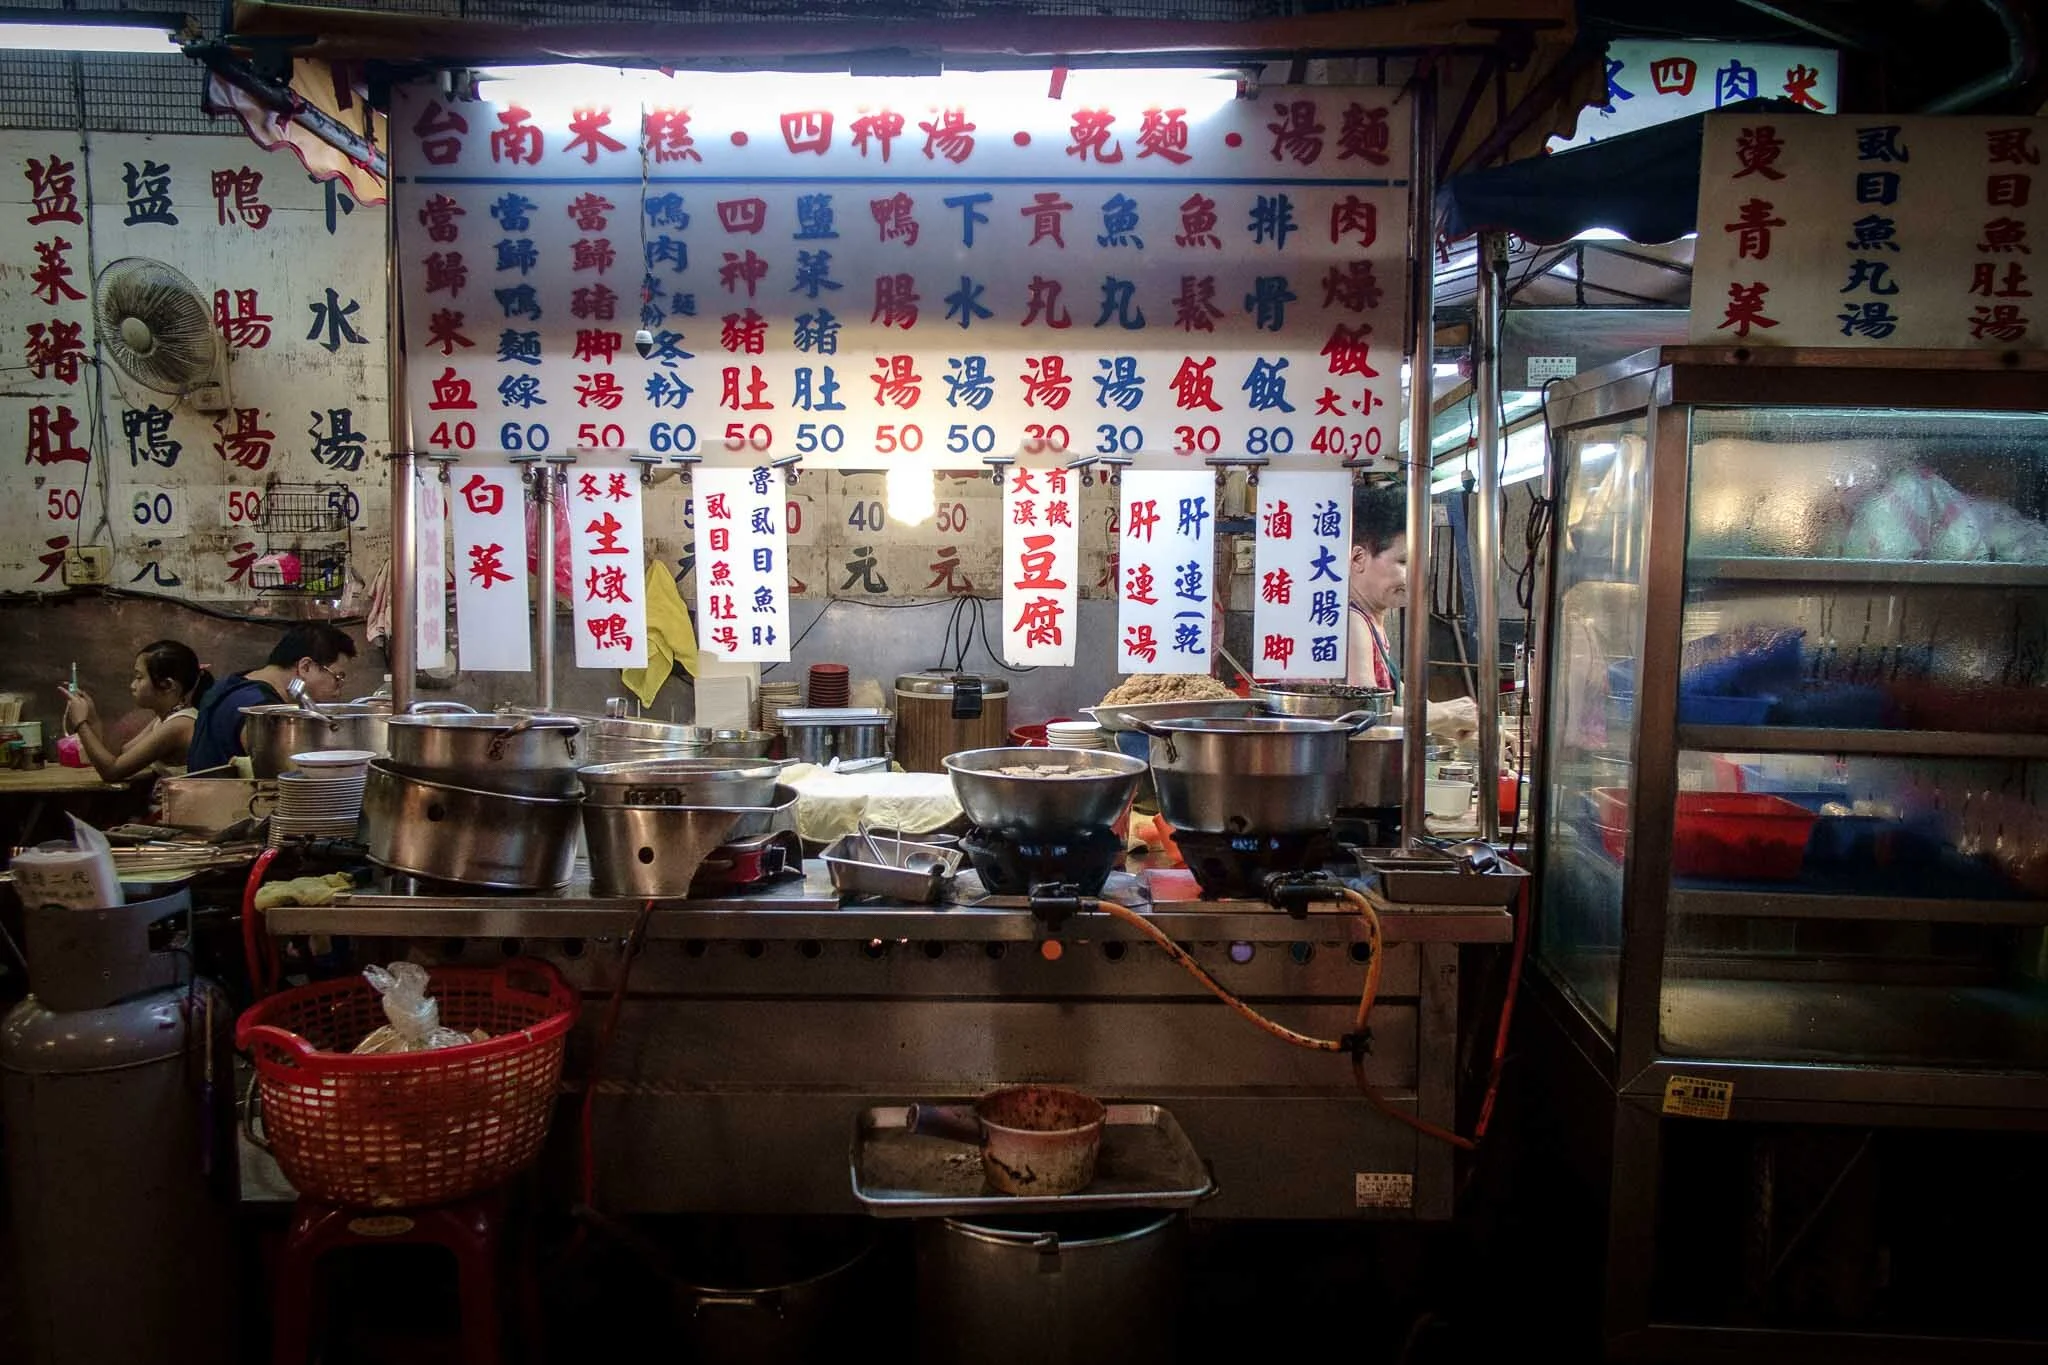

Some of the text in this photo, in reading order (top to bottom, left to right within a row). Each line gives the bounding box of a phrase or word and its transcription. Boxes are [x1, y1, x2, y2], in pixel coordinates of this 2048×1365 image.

[412, 99, 702, 166] 台南米糕
[780, 109, 976, 164] 四神湯
[1837, 126, 1909, 340] 虱目魚丸湯
[1967, 128, 2040, 341] 虱目魚肚湯
[211, 166, 276, 471] 鴨腸湯
[717, 198, 775, 451] 四神豬肚 50
[870, 192, 924, 452] 鴨腸湯 50
[943, 193, 995, 411] 下水湯
[1020, 193, 1073, 453] 貢丸湯 30
[1093, 194, 1146, 454] 魚丸湯 30
[1242, 195, 1298, 454] 排骨飯 80
[429, 423, 476, 450] 40
[501, 422, 550, 451] 60
[577, 424, 625, 450] 50
[650, 423, 697, 452] 60
[796, 424, 845, 452] 50
[947, 425, 996, 454] 50
[1174, 426, 1220, 455] 30
[48, 489, 80, 520] 50
[228, 491, 260, 522] 50
[459, 474, 515, 590] 白菜
[848, 501, 885, 531] 40
[936, 503, 967, 533] 50
[840, 546, 889, 593] 元
[924, 546, 975, 593] 元
[1013, 534, 1067, 649] 豆腐
[1123, 499, 1160, 664] 肝連湯
